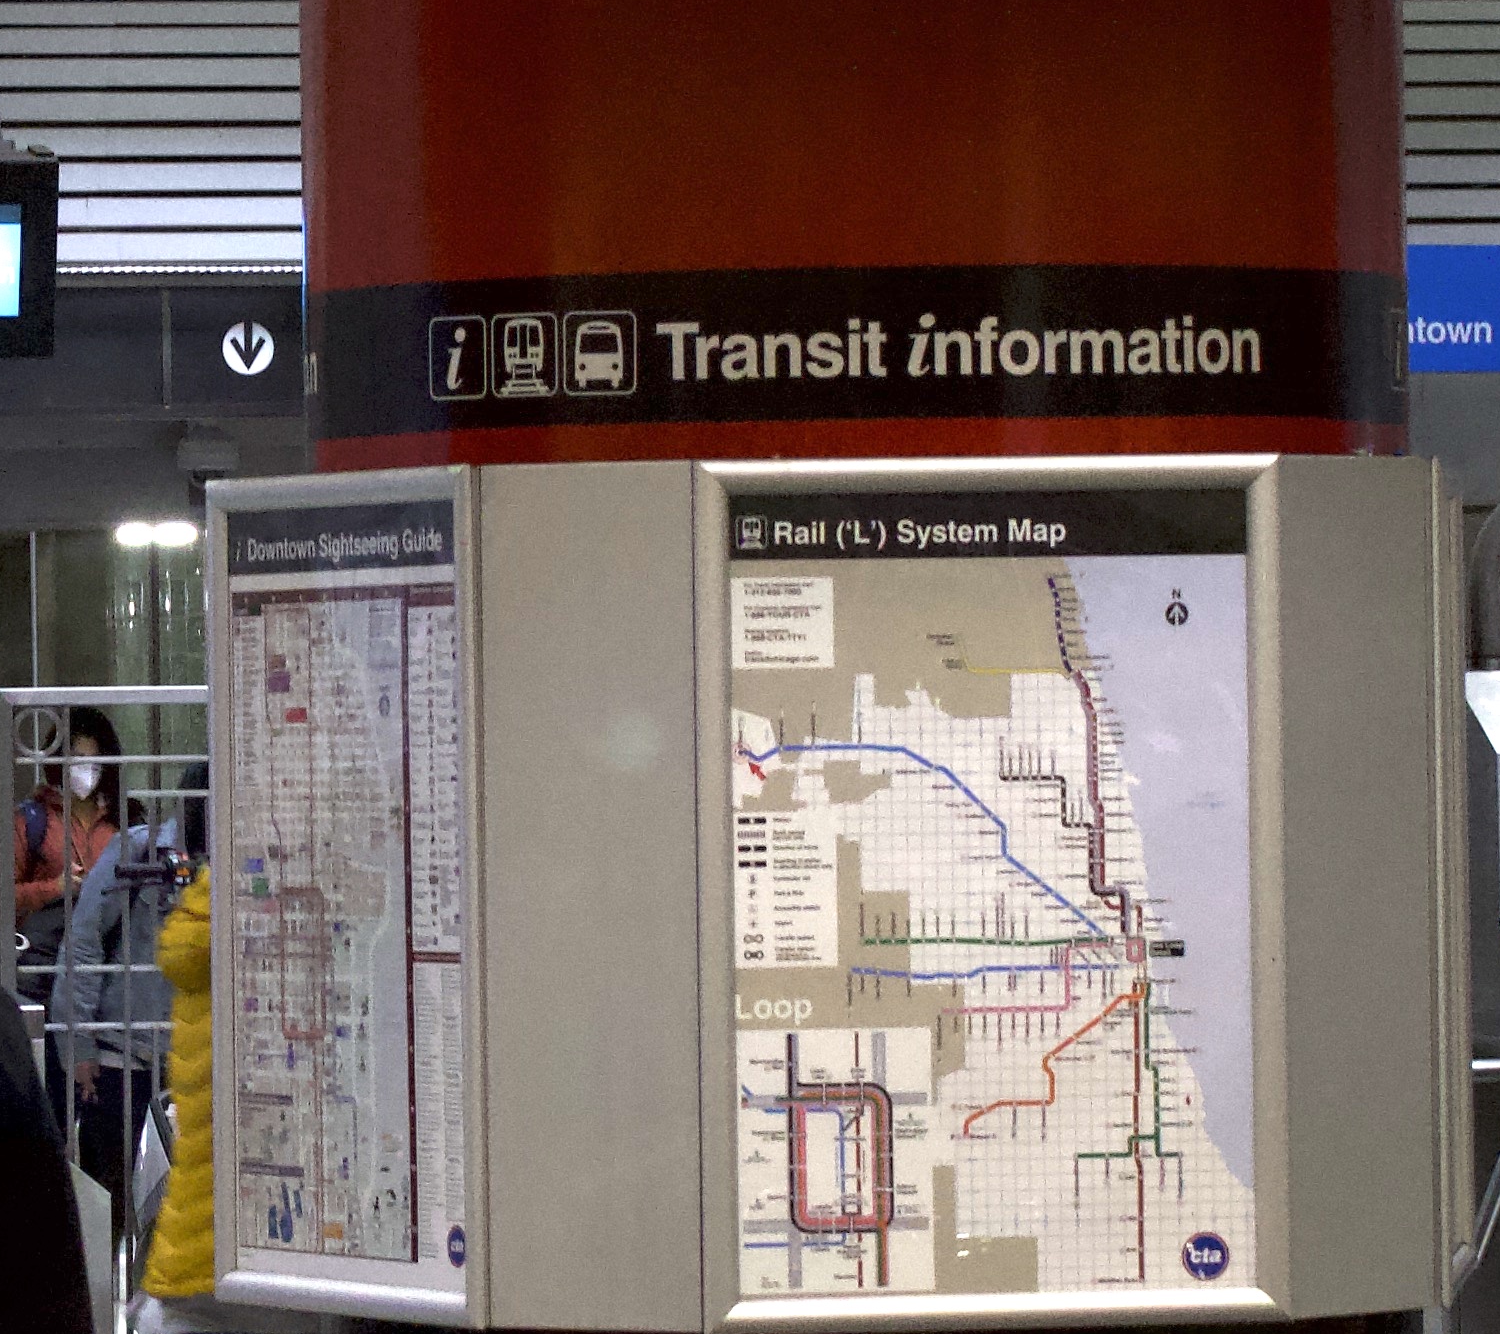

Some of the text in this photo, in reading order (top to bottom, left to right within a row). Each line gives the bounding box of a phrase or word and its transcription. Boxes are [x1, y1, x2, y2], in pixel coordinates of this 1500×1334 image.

[655, 313, 1263, 382] Transit information
[247, 537, 316, 562] Downtown
[318, 530, 399, 563] Sightseeing
[401, 527, 444, 554] Guide
[773, 519, 825, 546] Rail
[896, 518, 999, 553] System
[1007, 517, 1067, 549] Map
[1171, 588, 1182, 599] N
[734, 994, 814, 1026] Loop
